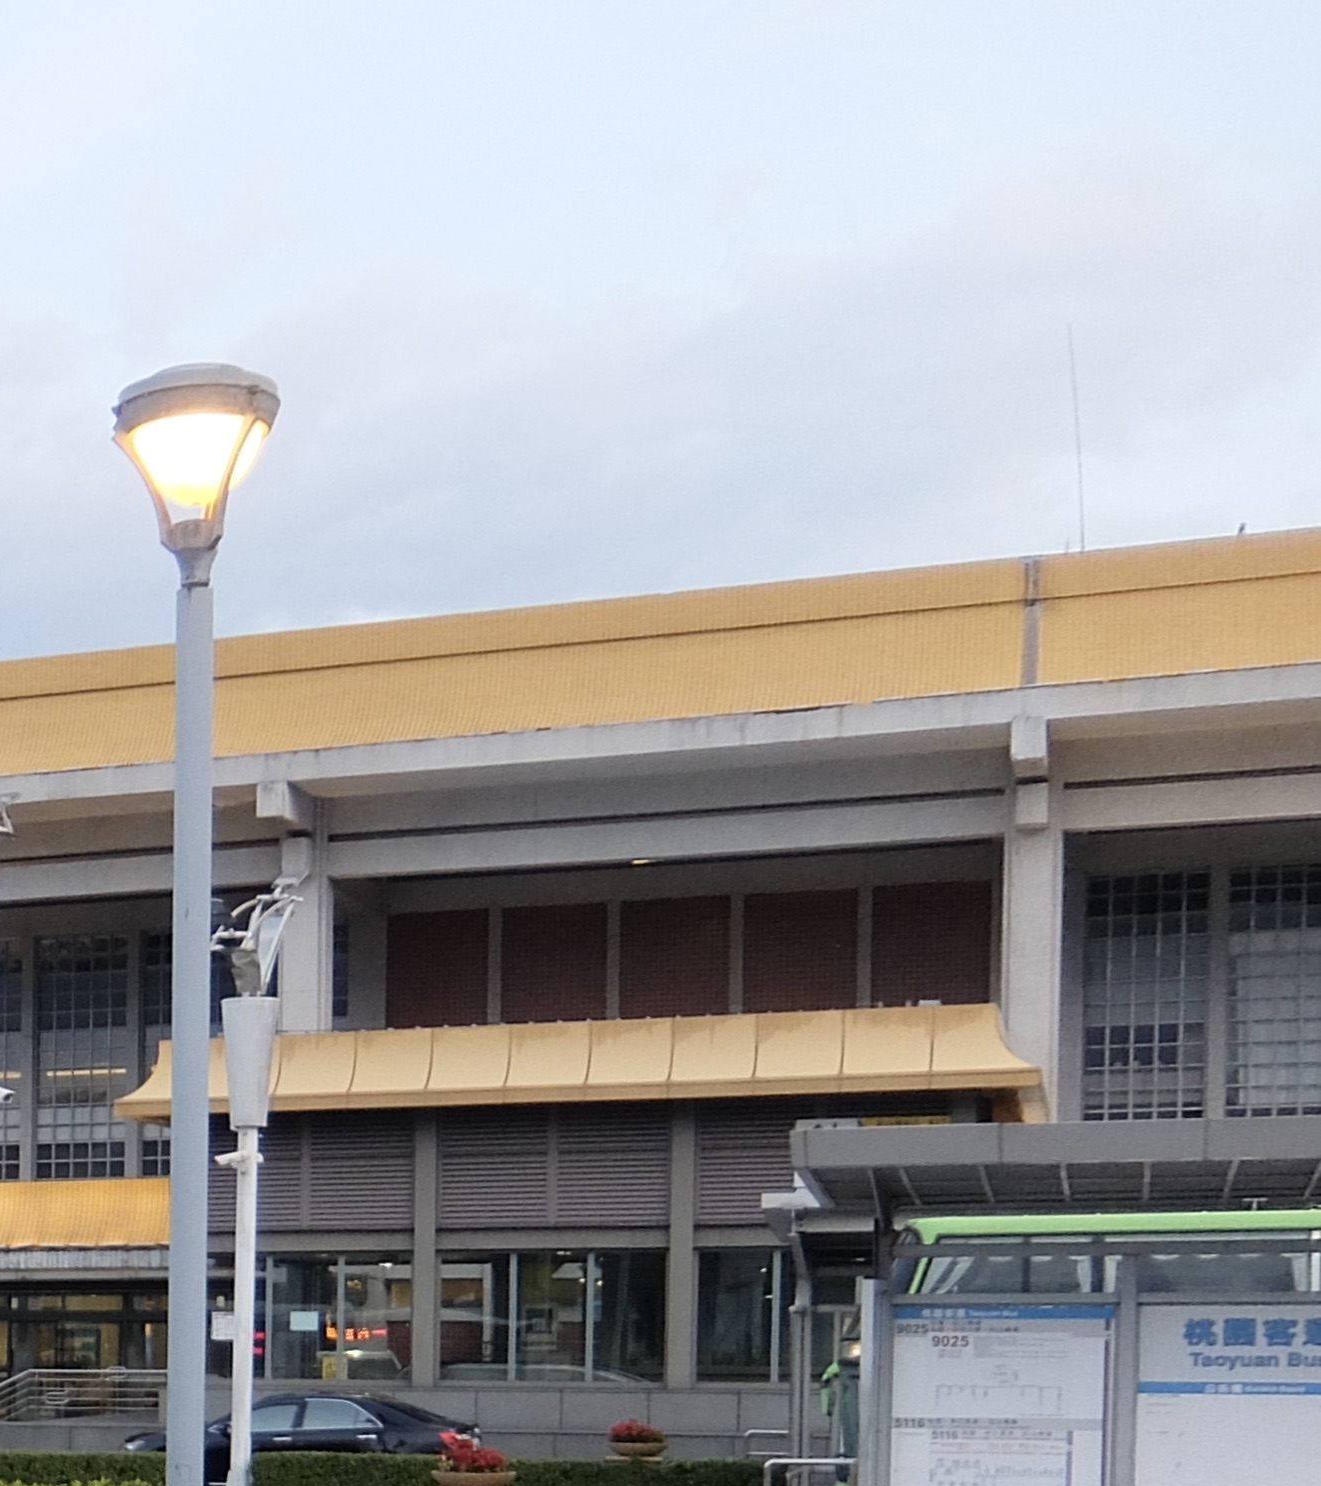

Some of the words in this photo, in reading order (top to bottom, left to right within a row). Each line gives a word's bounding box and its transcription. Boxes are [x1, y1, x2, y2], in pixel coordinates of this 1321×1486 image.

[895, 1324, 929, 1335] 9025
[931, 1335, 970, 1348] 9025
[1189, 1352, 1279, 1370] Taoyuan
[893, 1417, 926, 1429] 5116
[931, 1430, 959, 1440] 5116
